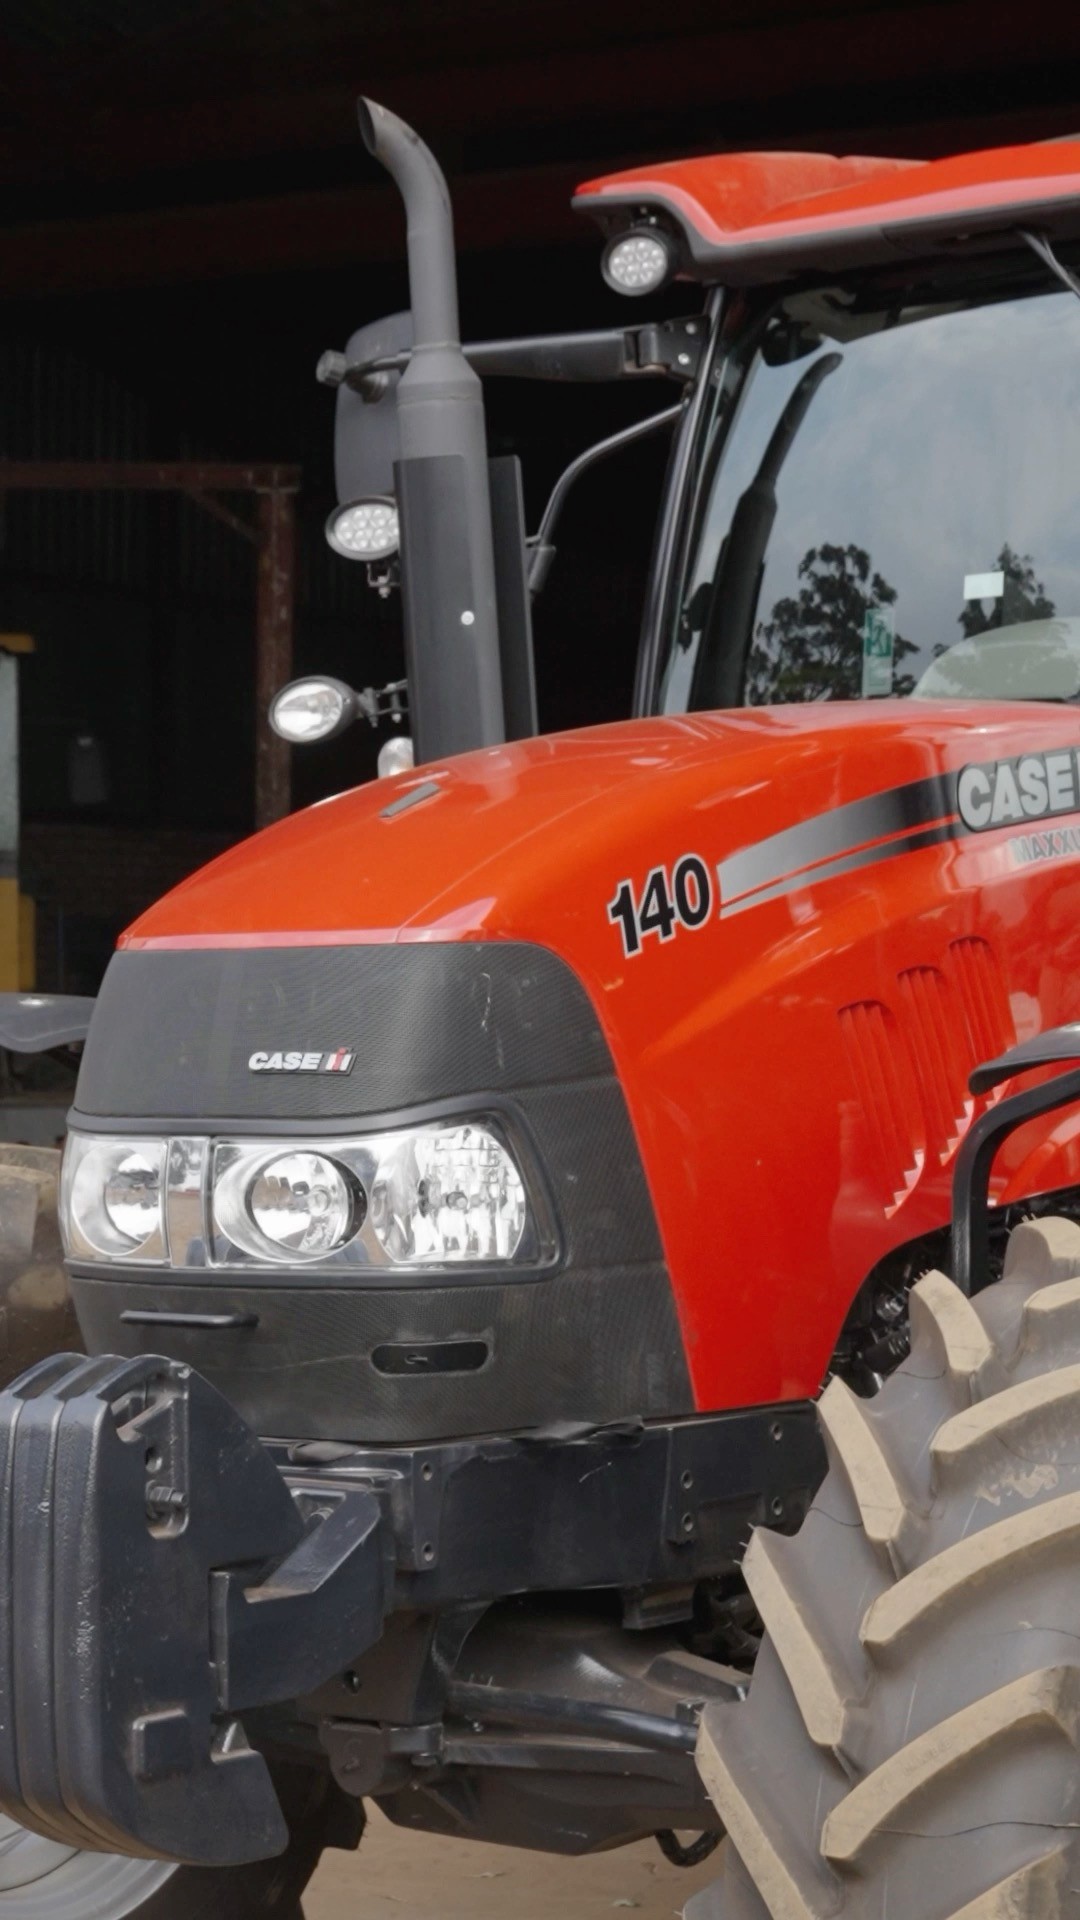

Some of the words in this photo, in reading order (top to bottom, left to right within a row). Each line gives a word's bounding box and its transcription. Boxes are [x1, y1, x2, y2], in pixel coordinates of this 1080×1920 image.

[957, 754, 1076, 828] CASE
[608, 854, 712, 959] 140
[248, 1051, 323, 1071] CASE
